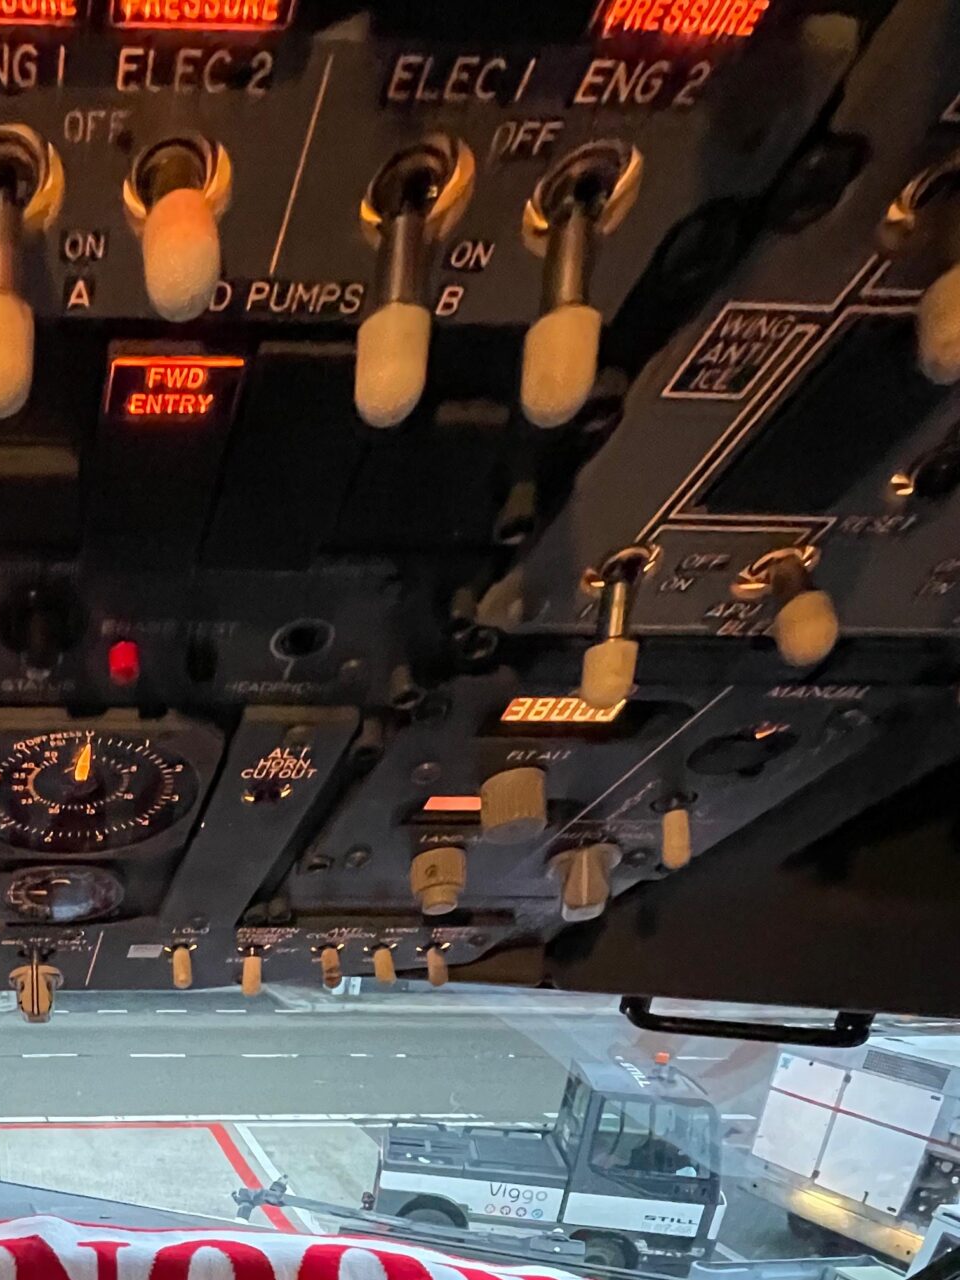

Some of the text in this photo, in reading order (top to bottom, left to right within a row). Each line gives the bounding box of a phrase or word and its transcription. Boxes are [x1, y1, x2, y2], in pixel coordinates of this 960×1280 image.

[603, 0, 770, 38] PRESSURE
[117, 48, 273, 96] ELEC 2
[388, 54, 501, 100] ELEC
[575, 59, 713, 106] ENG 2
[64, 109, 129, 143] OFF
[494, 121, 564, 155] OFF
[65, 233, 106, 260] ON
[451, 242, 496, 269] ON
[68, 279, 90, 309] A
[247, 282, 364, 315] PUMPS
[436, 285, 464, 317] B
[720, 315, 796, 339] WING
[698, 341, 773, 366] ANTI
[147, 367, 207, 389] FWD
[128, 393, 214, 415] ENTRY
[240, 768, 318, 779] CUTOUT
[257, 758, 311, 769] HORN
[490, 1182, 548, 1203] Viggo
[643, 1213, 699, 1226] STILL
